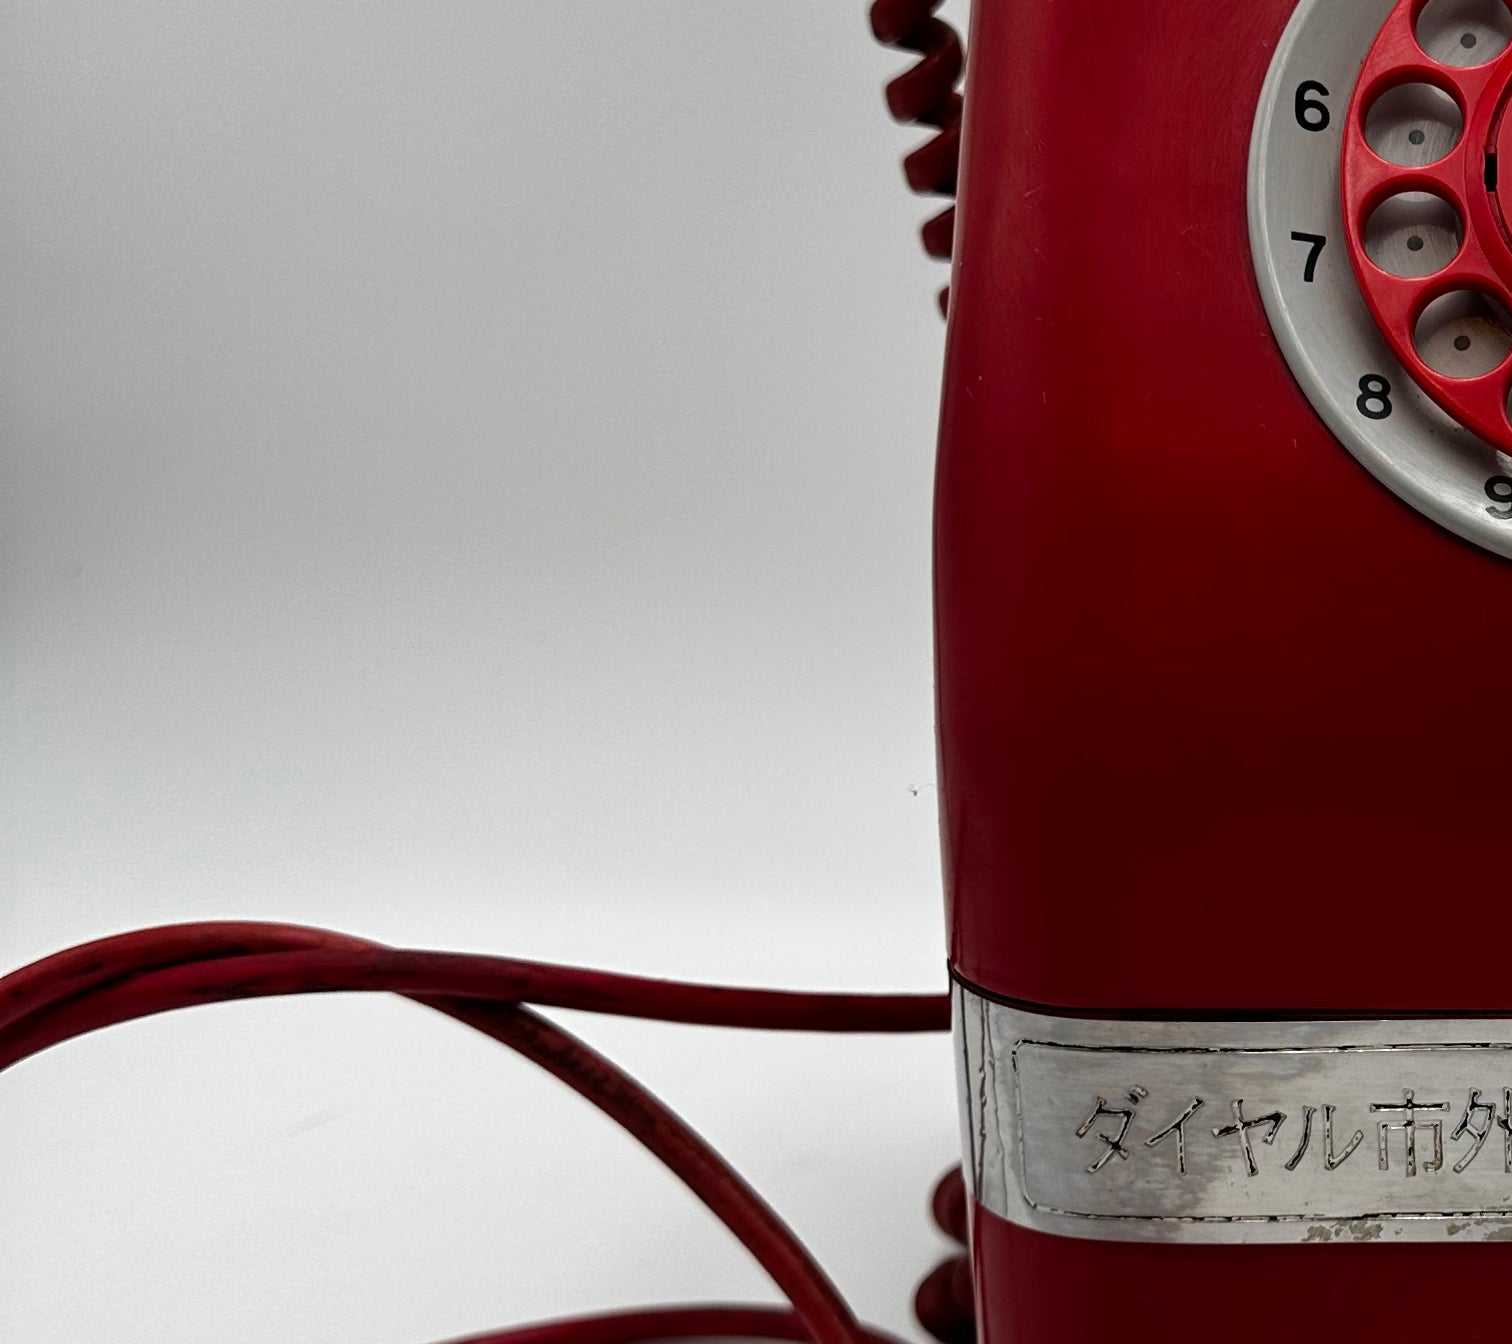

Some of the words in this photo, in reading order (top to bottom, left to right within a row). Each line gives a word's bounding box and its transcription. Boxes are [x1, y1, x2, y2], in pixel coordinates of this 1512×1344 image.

[1294, 79, 1331, 133] 6
[1290, 230, 1327, 283] 7
[1356, 374, 1393, 420] 8
